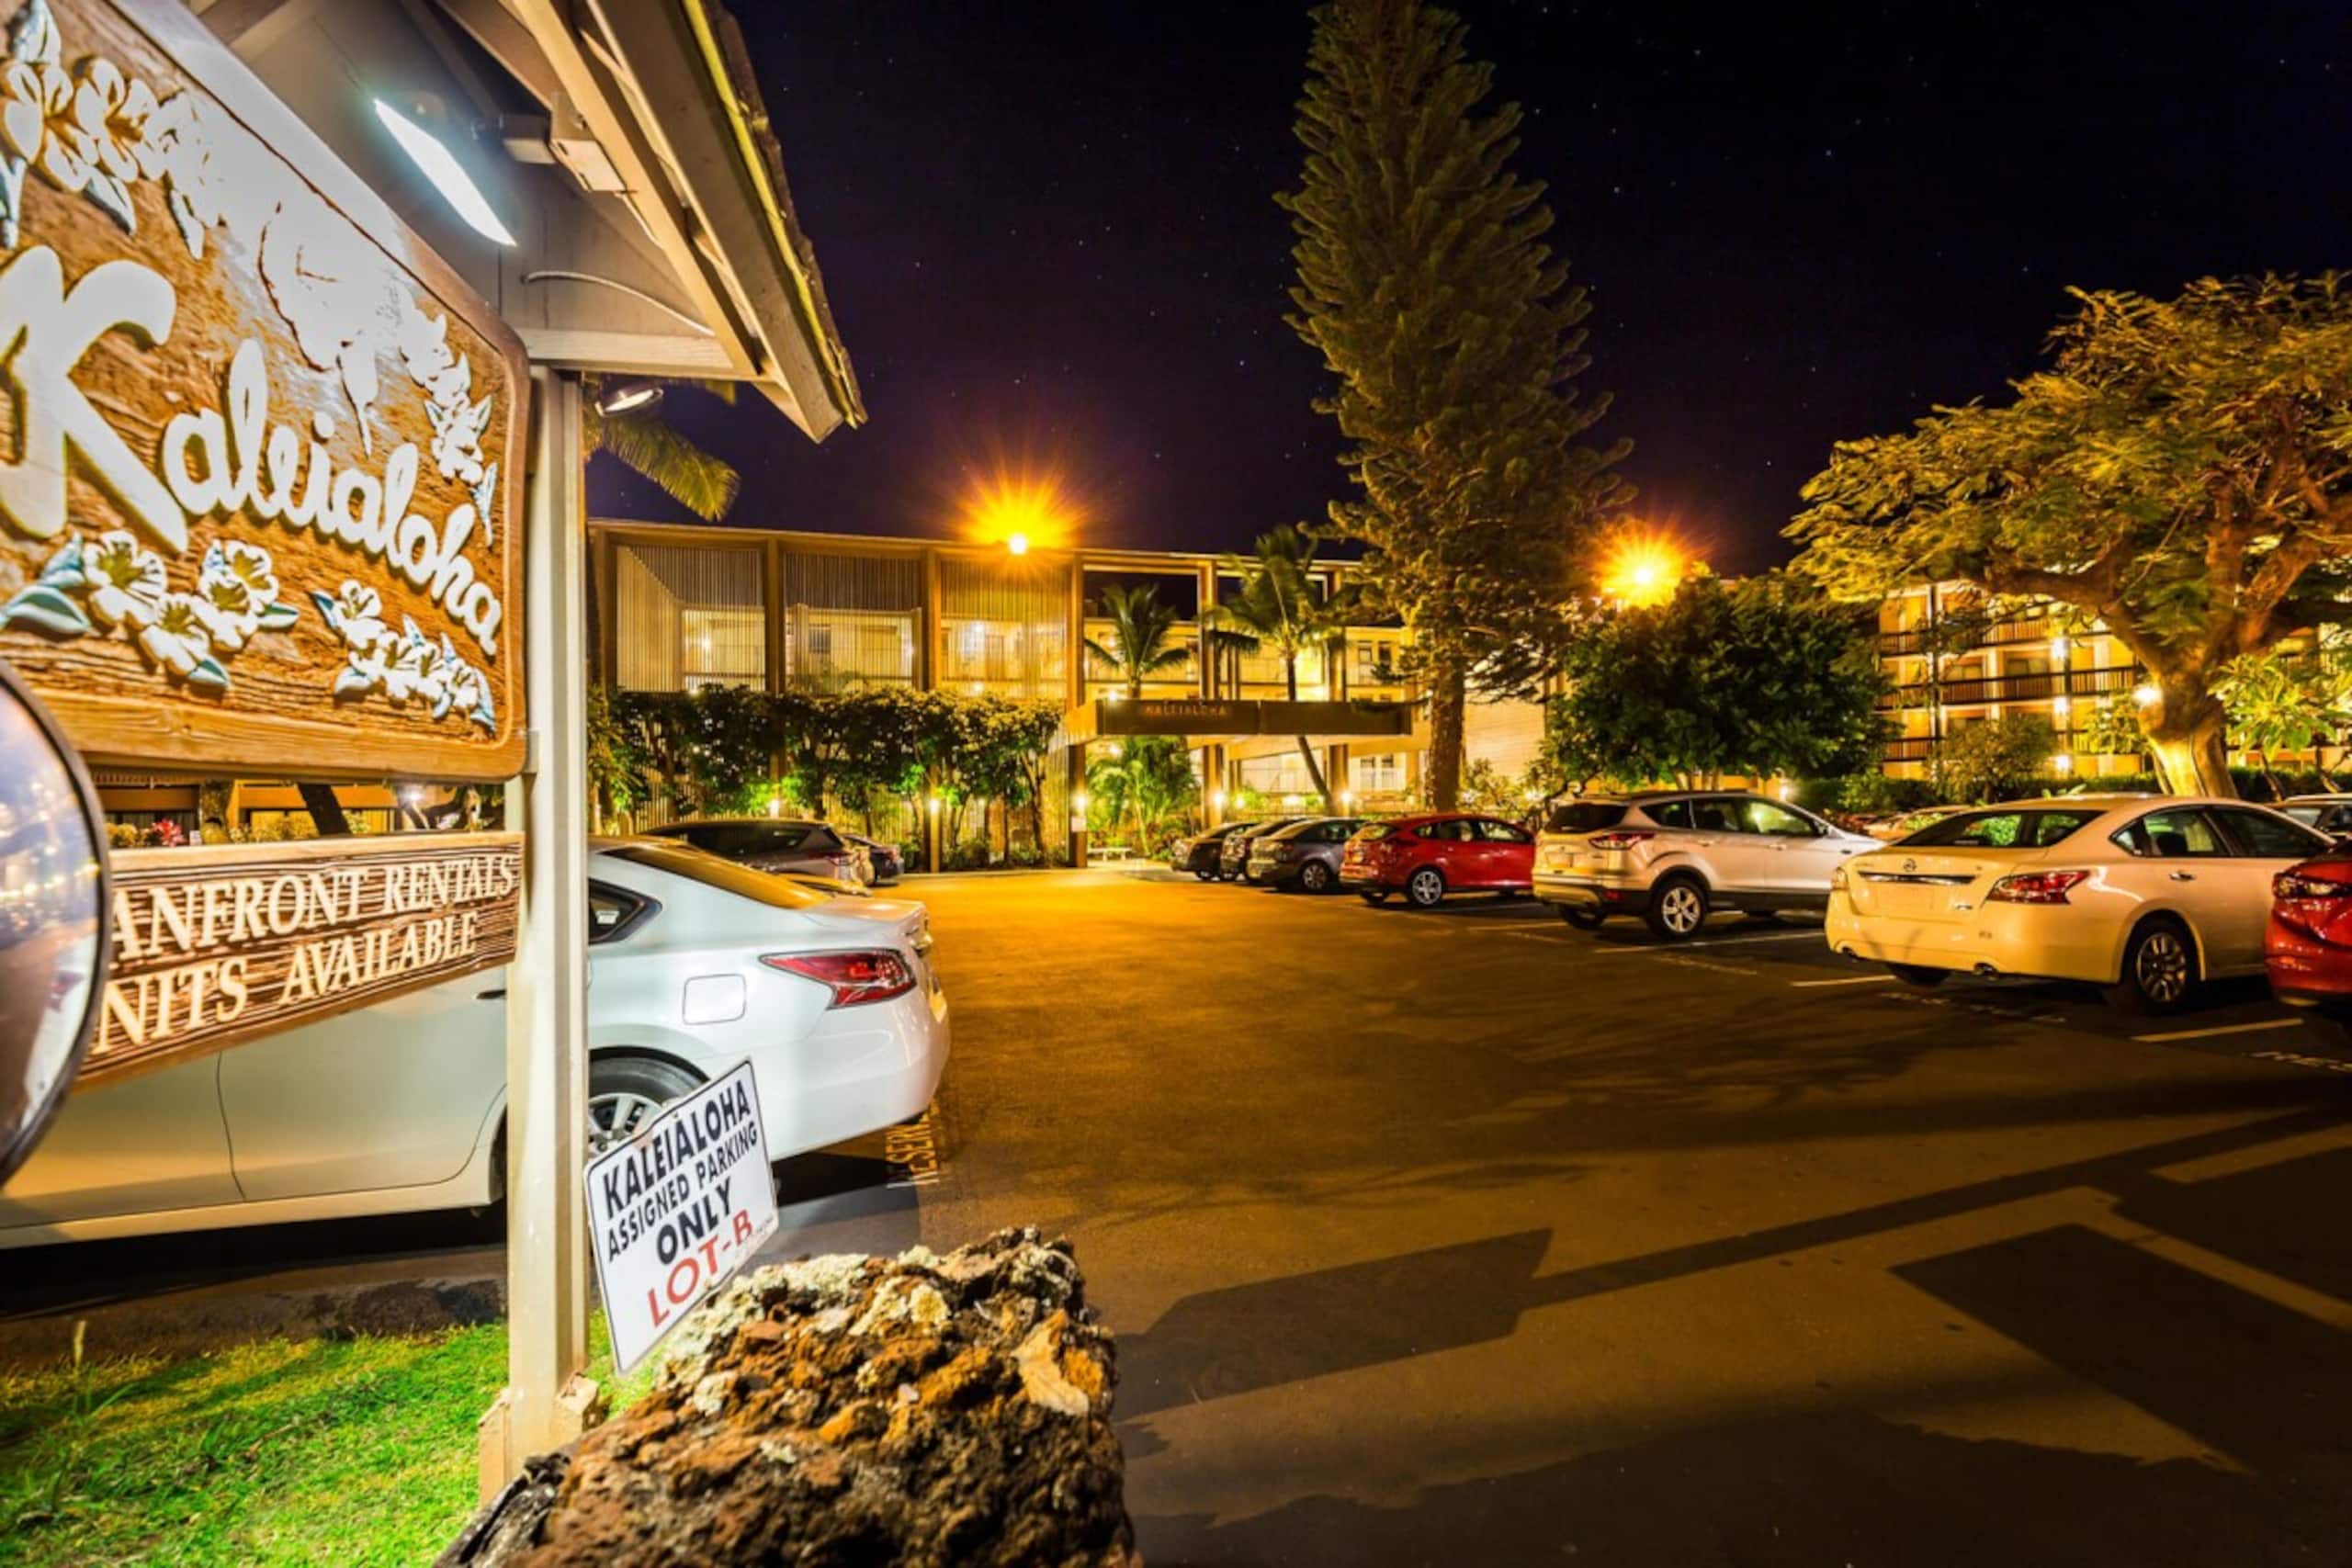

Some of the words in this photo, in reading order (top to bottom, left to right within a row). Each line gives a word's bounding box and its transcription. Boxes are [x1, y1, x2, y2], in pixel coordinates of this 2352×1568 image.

[0, 244, 502, 656] Kaleialoha
[383, 855, 515, 911] RENTALS
[93, 957, 248, 1055] NITS
[281, 913, 477, 1003] AVAILABLE
[603, 1079, 751, 1221] KALEIALOHA
[607, 1172, 689, 1262] ASSIGNED
[695, 1120, 757, 1187] PARKING
[647, 1209, 753, 1329] LOT-B
[657, 1177, 732, 1266] ONLY
